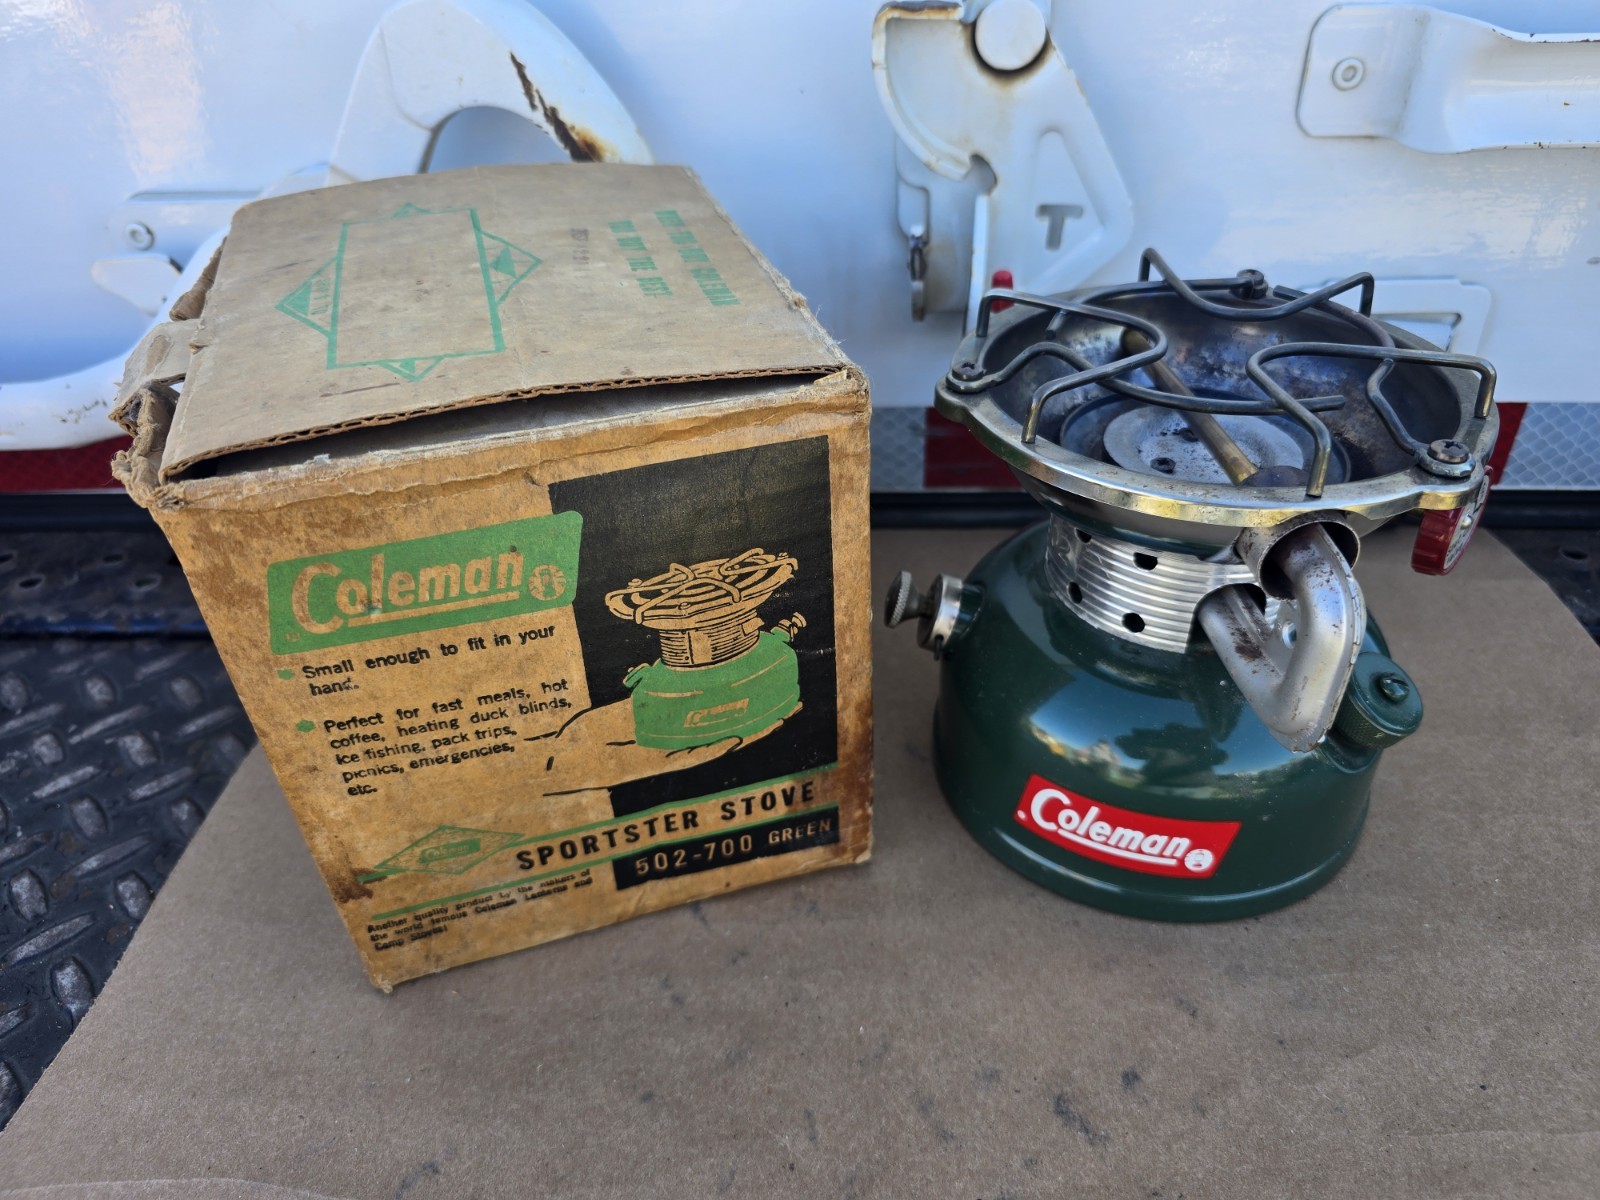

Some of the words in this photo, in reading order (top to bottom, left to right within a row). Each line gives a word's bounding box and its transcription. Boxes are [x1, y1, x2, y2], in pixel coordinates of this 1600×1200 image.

[291, 553, 524, 634] Coleman
[302, 659, 354, 679] Small
[365, 644, 430, 669] enough
[440, 643, 459, 657] to
[468, 637, 487, 652] fit
[494, 633, 512, 646] in
[519, 625, 556, 645] your
[323, 712, 384, 733] Perfect
[396, 707, 420, 720] for
[432, 698, 464, 714] fast
[477, 687, 531, 706] meals,
[540, 678, 569, 694] hot
[330, 732, 386, 749] coffee,
[396, 718, 460, 737] heating
[469, 707, 509, 724] duck
[518, 697, 572, 715] blinds,
[342, 763, 405, 784] picnics,
[409, 742, 516, 770] emergencies,
[431, 732, 470, 750] pack
[474, 725, 518, 740] trips,
[347, 783, 378, 796] etc.
[516, 809, 700, 871] SPORTSTER
[720, 780, 815, 822] STOVE
[634, 834, 753, 876] 502-700
[767, 816, 832, 845] GREEN
[1030, 788, 1193, 858] Coleman
[370, 933, 389, 942] the
[394, 922, 424, 935] world
[431, 911, 468, 925] famous
[474, 898, 518, 914] Coleman
[574, 876, 593, 889] and
[414, 906, 449, 921] quality
[455, 894, 493, 911] product
[517, 884, 534, 893] the
[580, 868, 592, 878] of
[374, 939, 405, 951] Camp
